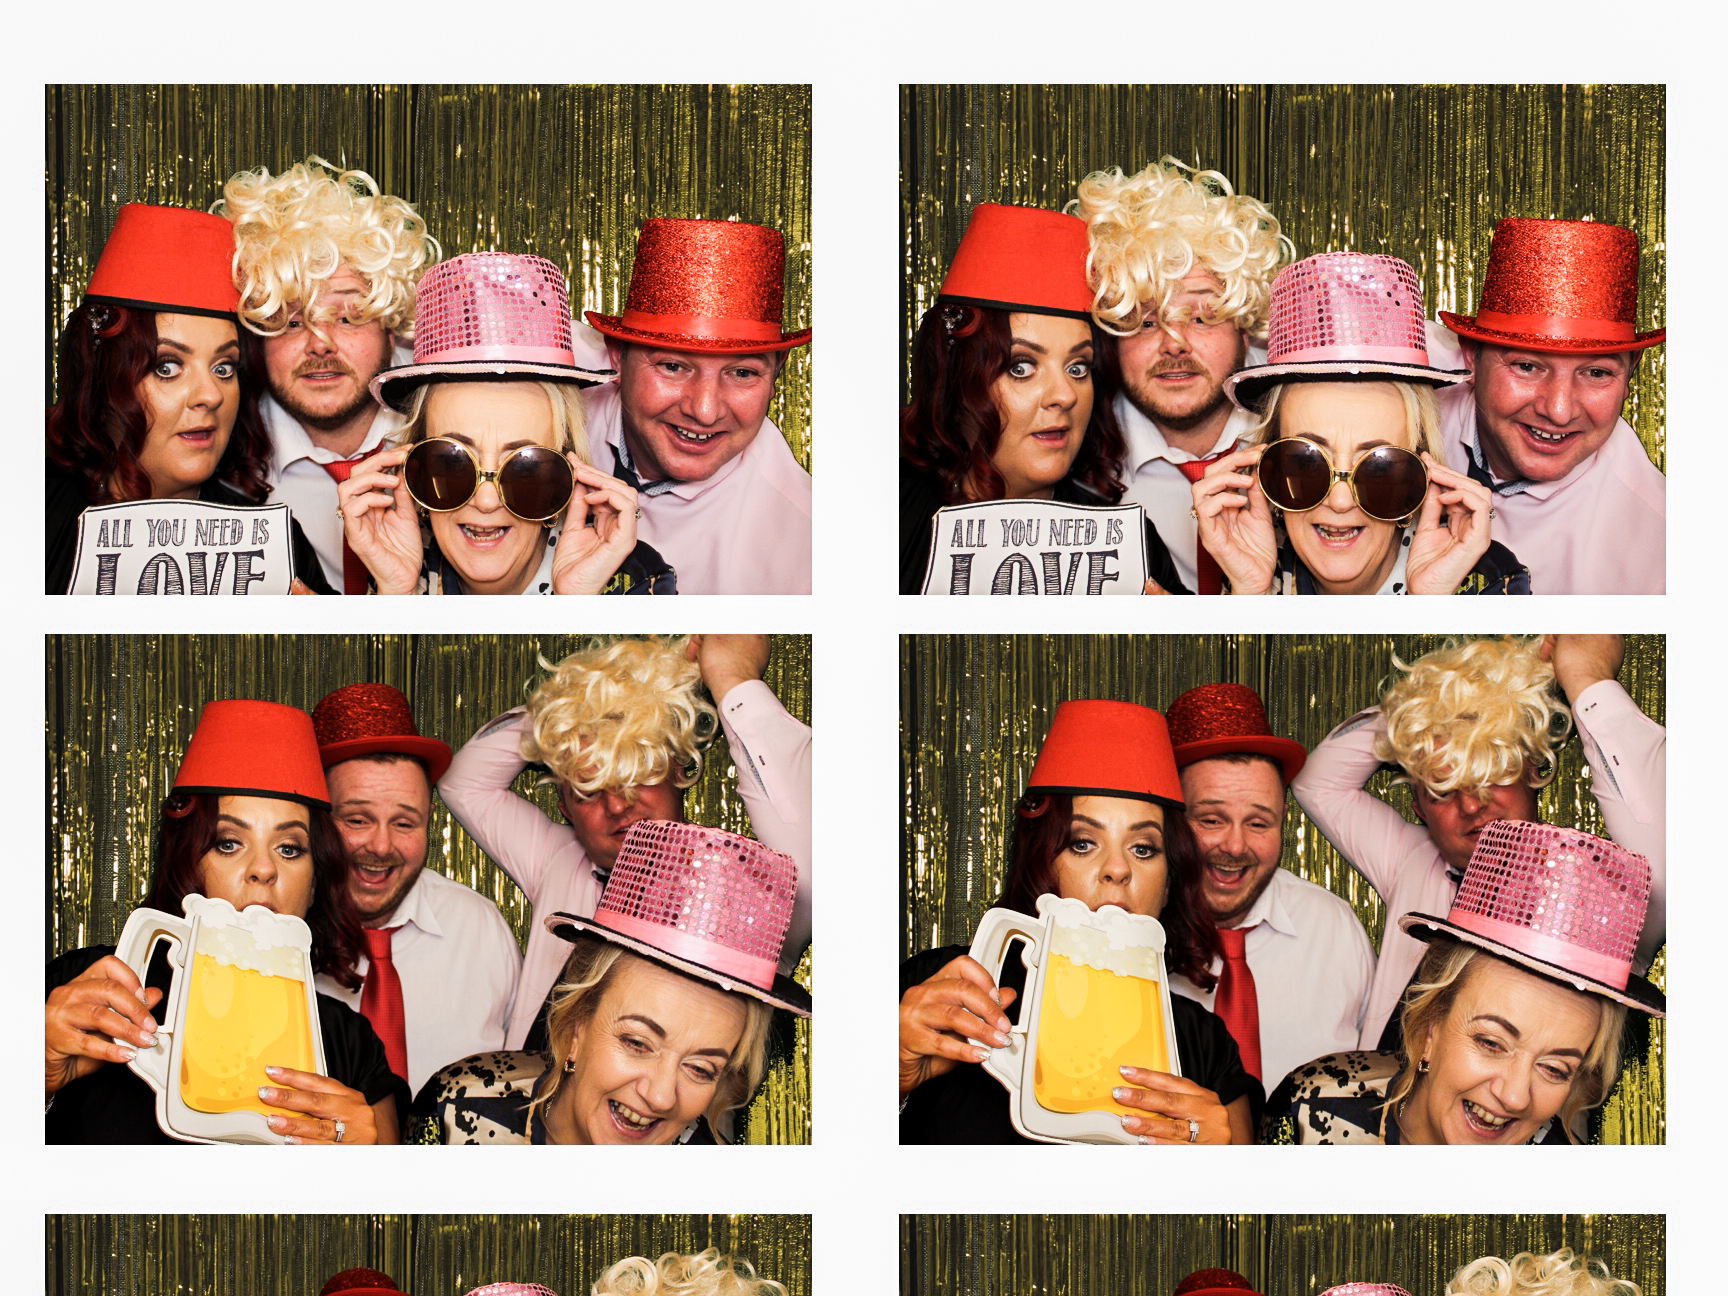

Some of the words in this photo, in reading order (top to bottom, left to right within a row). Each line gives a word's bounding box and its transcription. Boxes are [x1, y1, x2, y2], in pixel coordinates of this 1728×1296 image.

[96, 518, 134, 547] ALL
[146, 518, 187, 547] YOU
[194, 518, 244, 547] NEED
[250, 518, 270, 546] IS
[950, 518, 988, 547] ALL
[1000, 518, 1041, 547] YOU
[1048, 518, 1098, 547] NEED
[1104, 518, 1124, 546] IS
